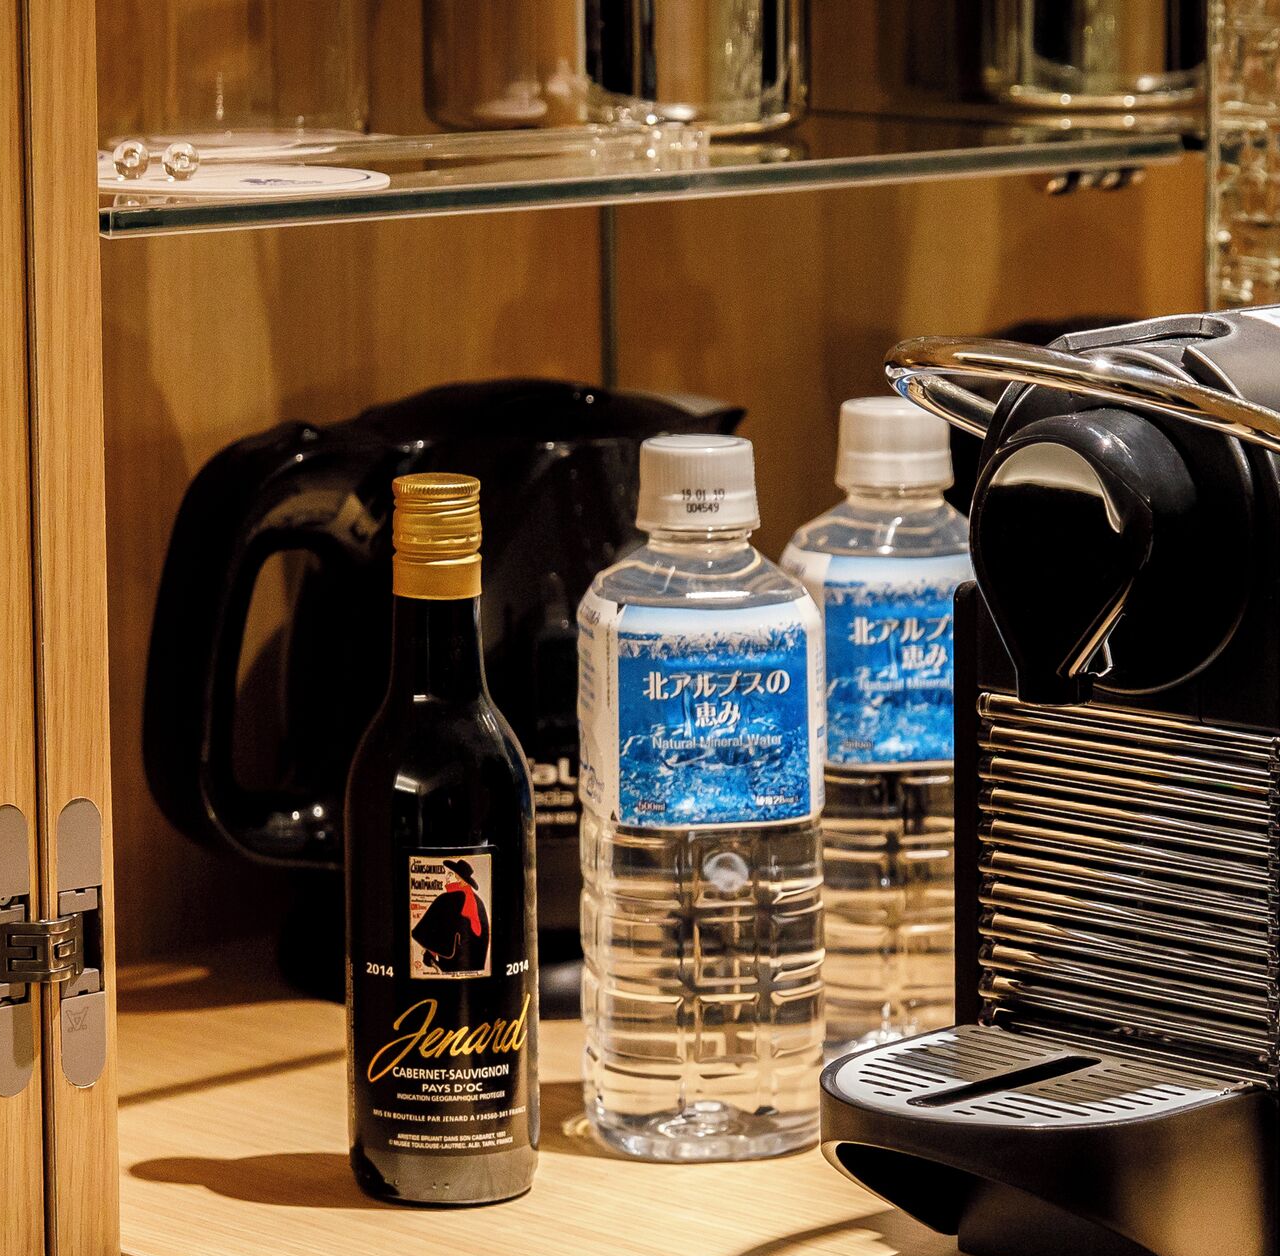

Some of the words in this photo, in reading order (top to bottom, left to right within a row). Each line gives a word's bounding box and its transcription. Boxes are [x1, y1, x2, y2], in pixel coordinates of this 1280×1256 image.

[848, 614, 953, 645] 北アルプ
[901, 643, 948, 670] 恵み
[643, 670, 791, 700] 北アルプスの
[694, 701, 741, 728] 恵み
[652, 737, 695, 749] Natural
[699, 735, 742, 748] Mineral
[747, 734, 782, 746] Water
[366, 962, 394, 977] 2014
[506, 960, 529, 976] 2014
[367, 993, 530, 1083] Jenard
[392, 1064, 509, 1080] CABERNET-SAUVIGNON
[422, 1083, 450, 1093] PAYS
[454, 1083, 483, 1092] D'OC
[397, 1093, 430, 1101] INDICATION
[373, 1109, 382, 1117] MIS
[393, 1112, 425, 1122] BOUTEILLE
